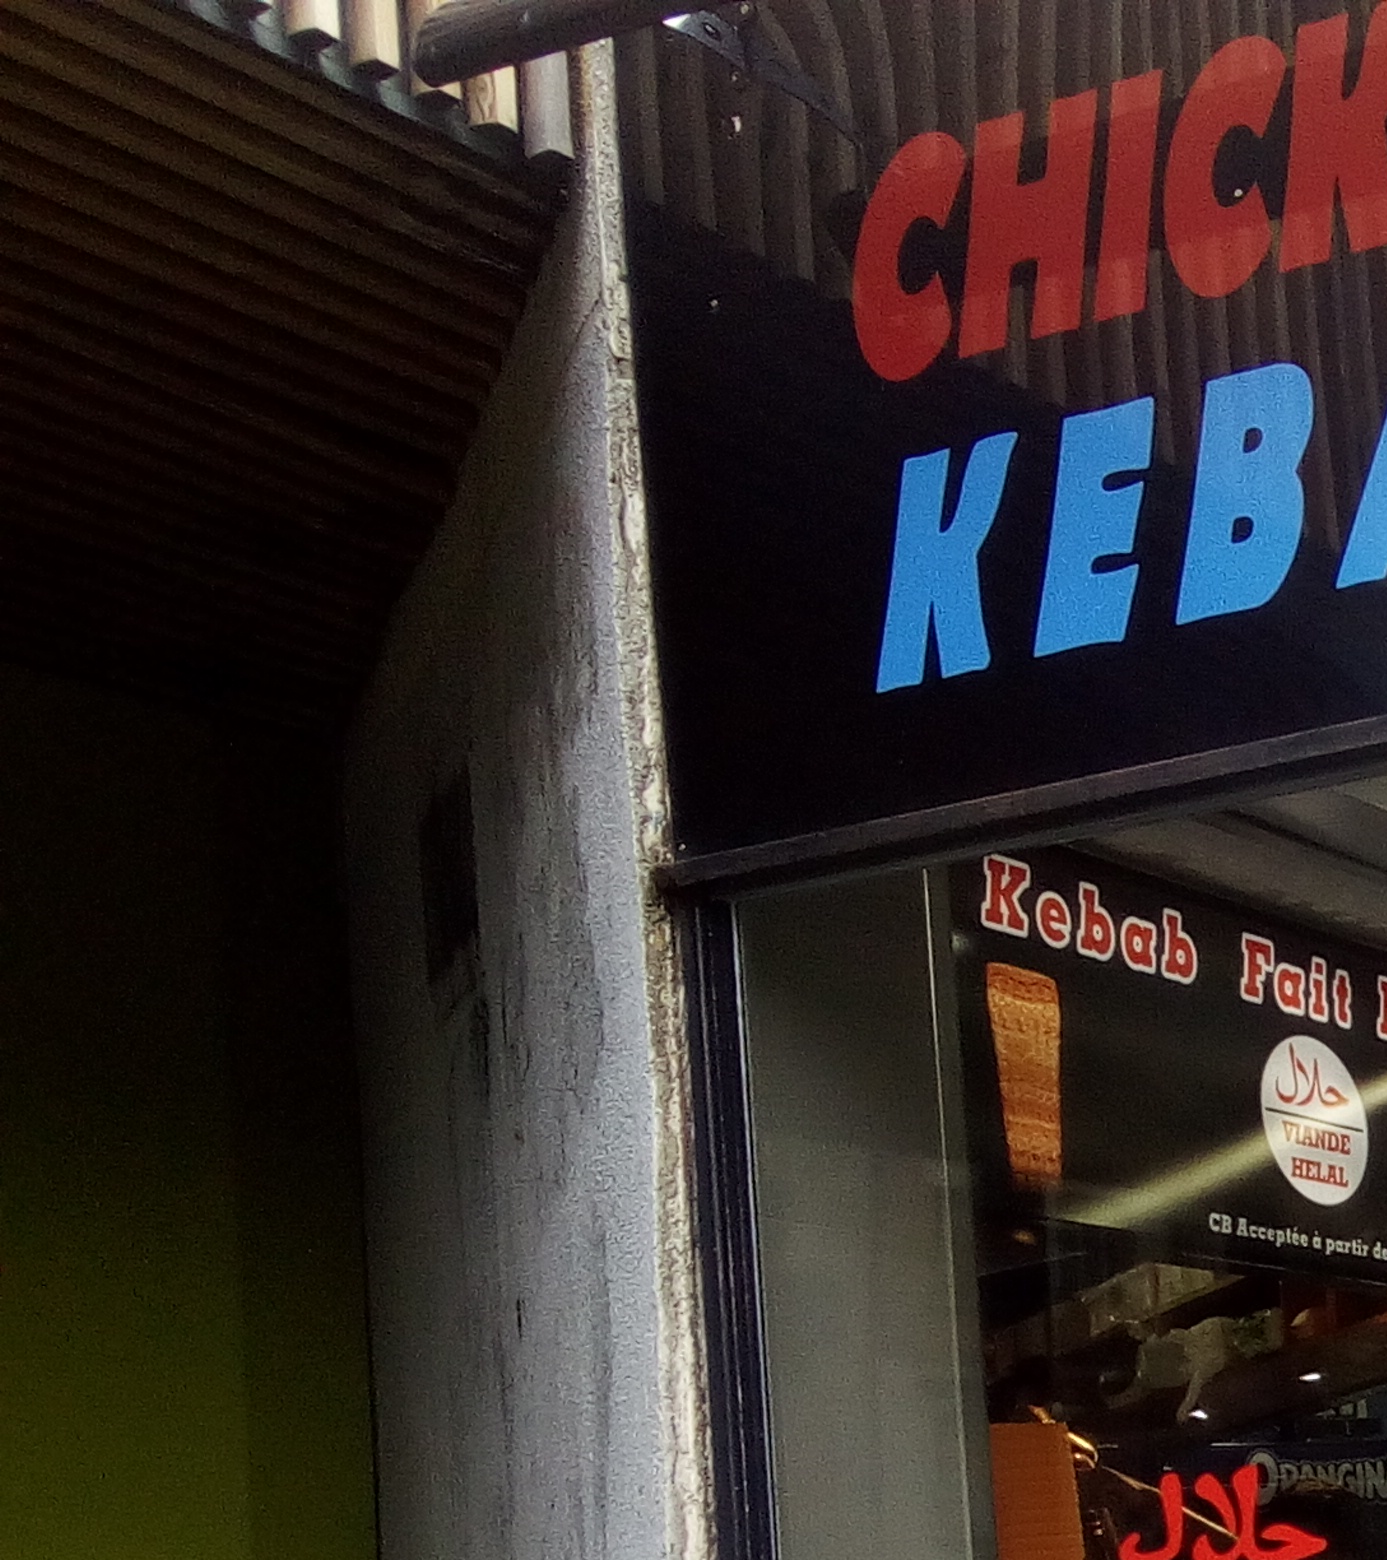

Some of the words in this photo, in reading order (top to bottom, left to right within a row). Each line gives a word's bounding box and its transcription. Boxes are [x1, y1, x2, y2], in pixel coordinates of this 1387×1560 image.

[981, 853, 1198, 985] Kebab
[1240, 931, 1352, 1030] Fait
[1274, 1041, 1351, 1109] حلال
[1282, 1119, 1351, 1156] VIANDE
[1290, 1156, 1349, 1188] HELAL
[1208, 1211, 1233, 1235] CB
[1236, 1216, 1309, 1249] Acceptée
[1312, 1230, 1323, 1250] à
[1325, 1236, 1369, 1256] partir
